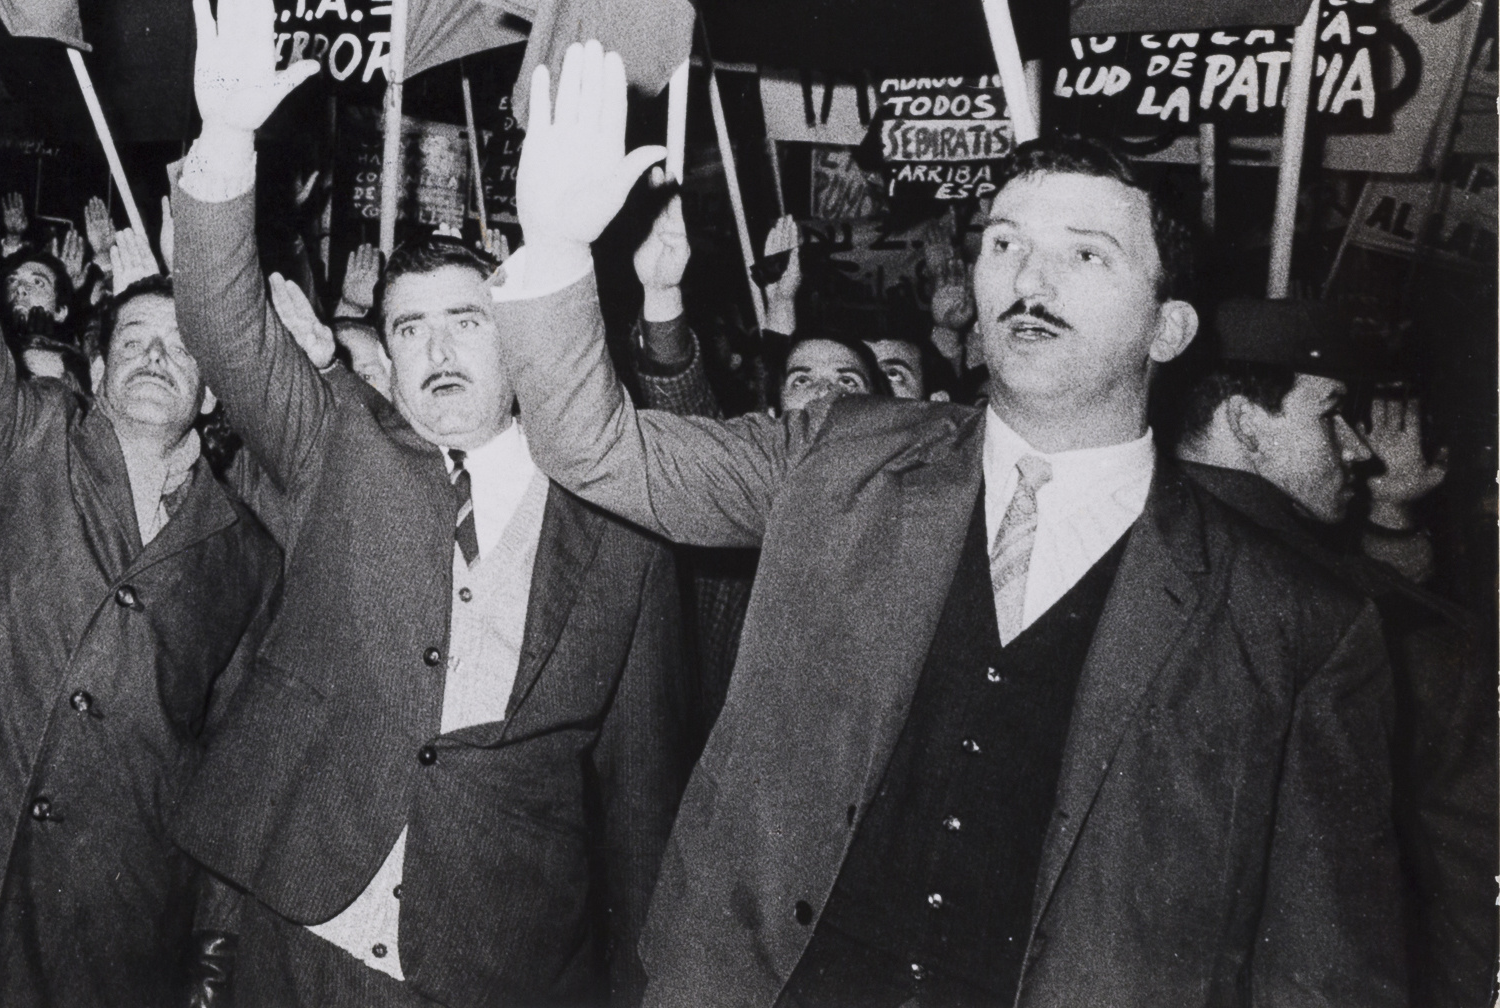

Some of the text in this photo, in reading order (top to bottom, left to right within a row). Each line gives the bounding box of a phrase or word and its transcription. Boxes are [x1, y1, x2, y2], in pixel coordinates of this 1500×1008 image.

[274, 31, 395, 83] ERROR
[1146, 51, 1198, 78] DE
[1052, 65, 1132, 98] LUD
[882, 94, 997, 120] TODOS
[1136, 85, 1191, 123] LA
